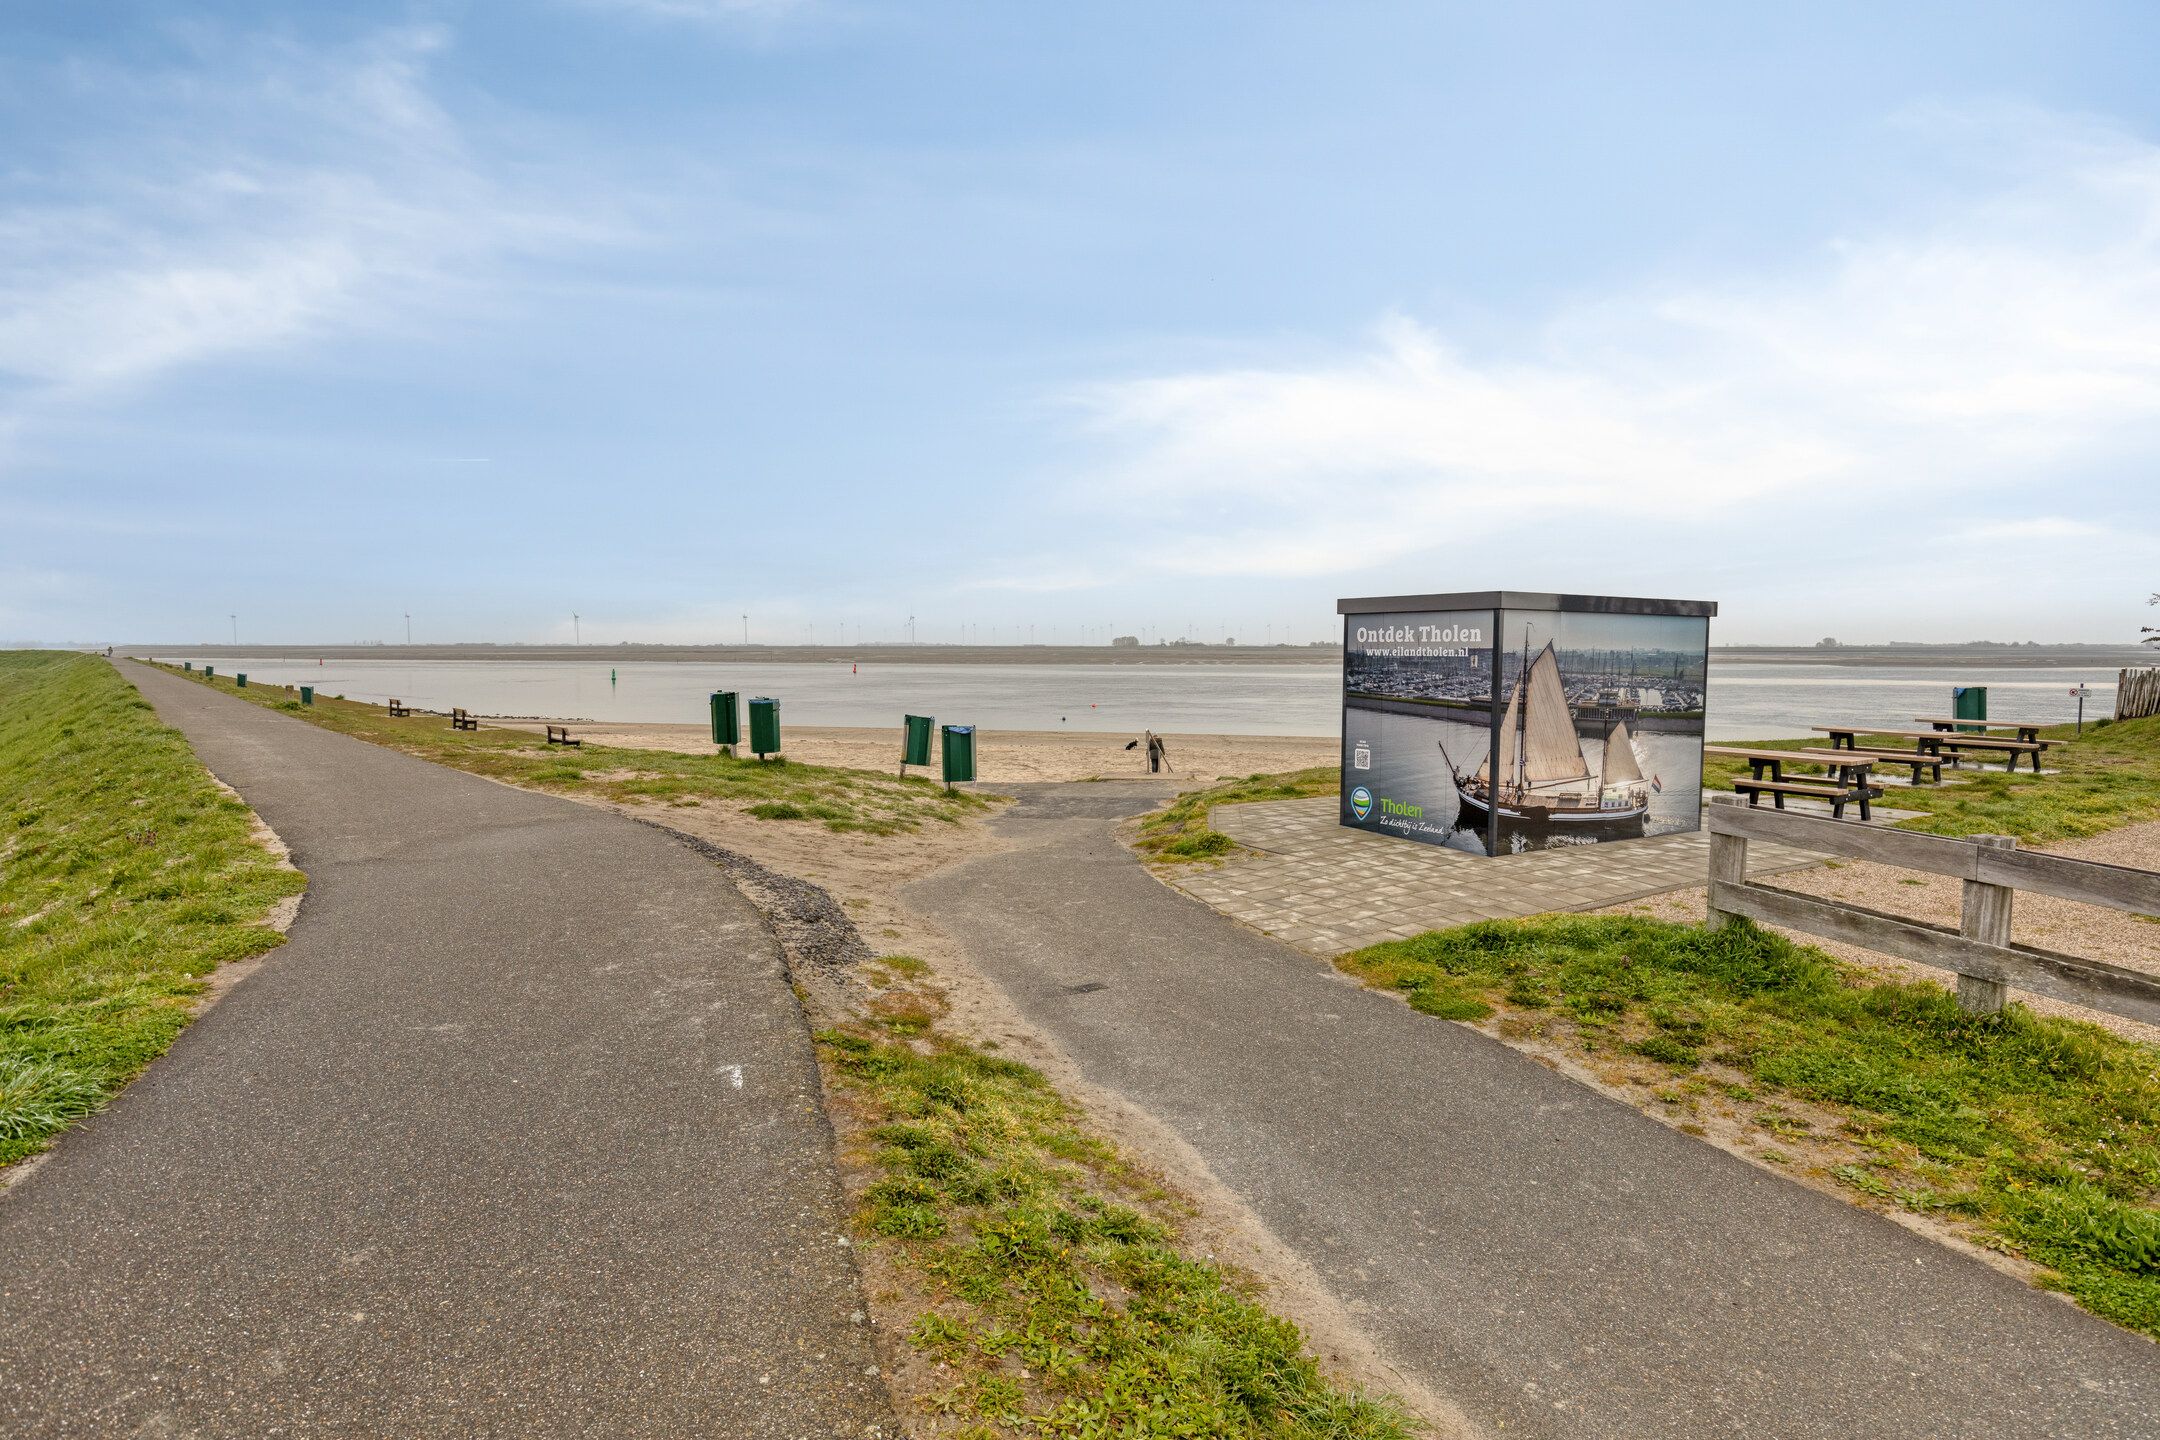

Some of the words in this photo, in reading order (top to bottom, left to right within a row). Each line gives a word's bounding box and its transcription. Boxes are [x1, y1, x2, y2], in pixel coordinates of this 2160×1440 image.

[1356, 626, 1415, 642] Ontdek
[1419, 625, 1482, 642] Tholen
[1366, 647, 1469, 657] www.eilandtholen.nl
[1380, 798, 1423, 818] Tholen
[1380, 816, 1388, 825] Zo
[1389, 818, 1411, 835] dichtbij
[1412, 822, 1418, 830] is
